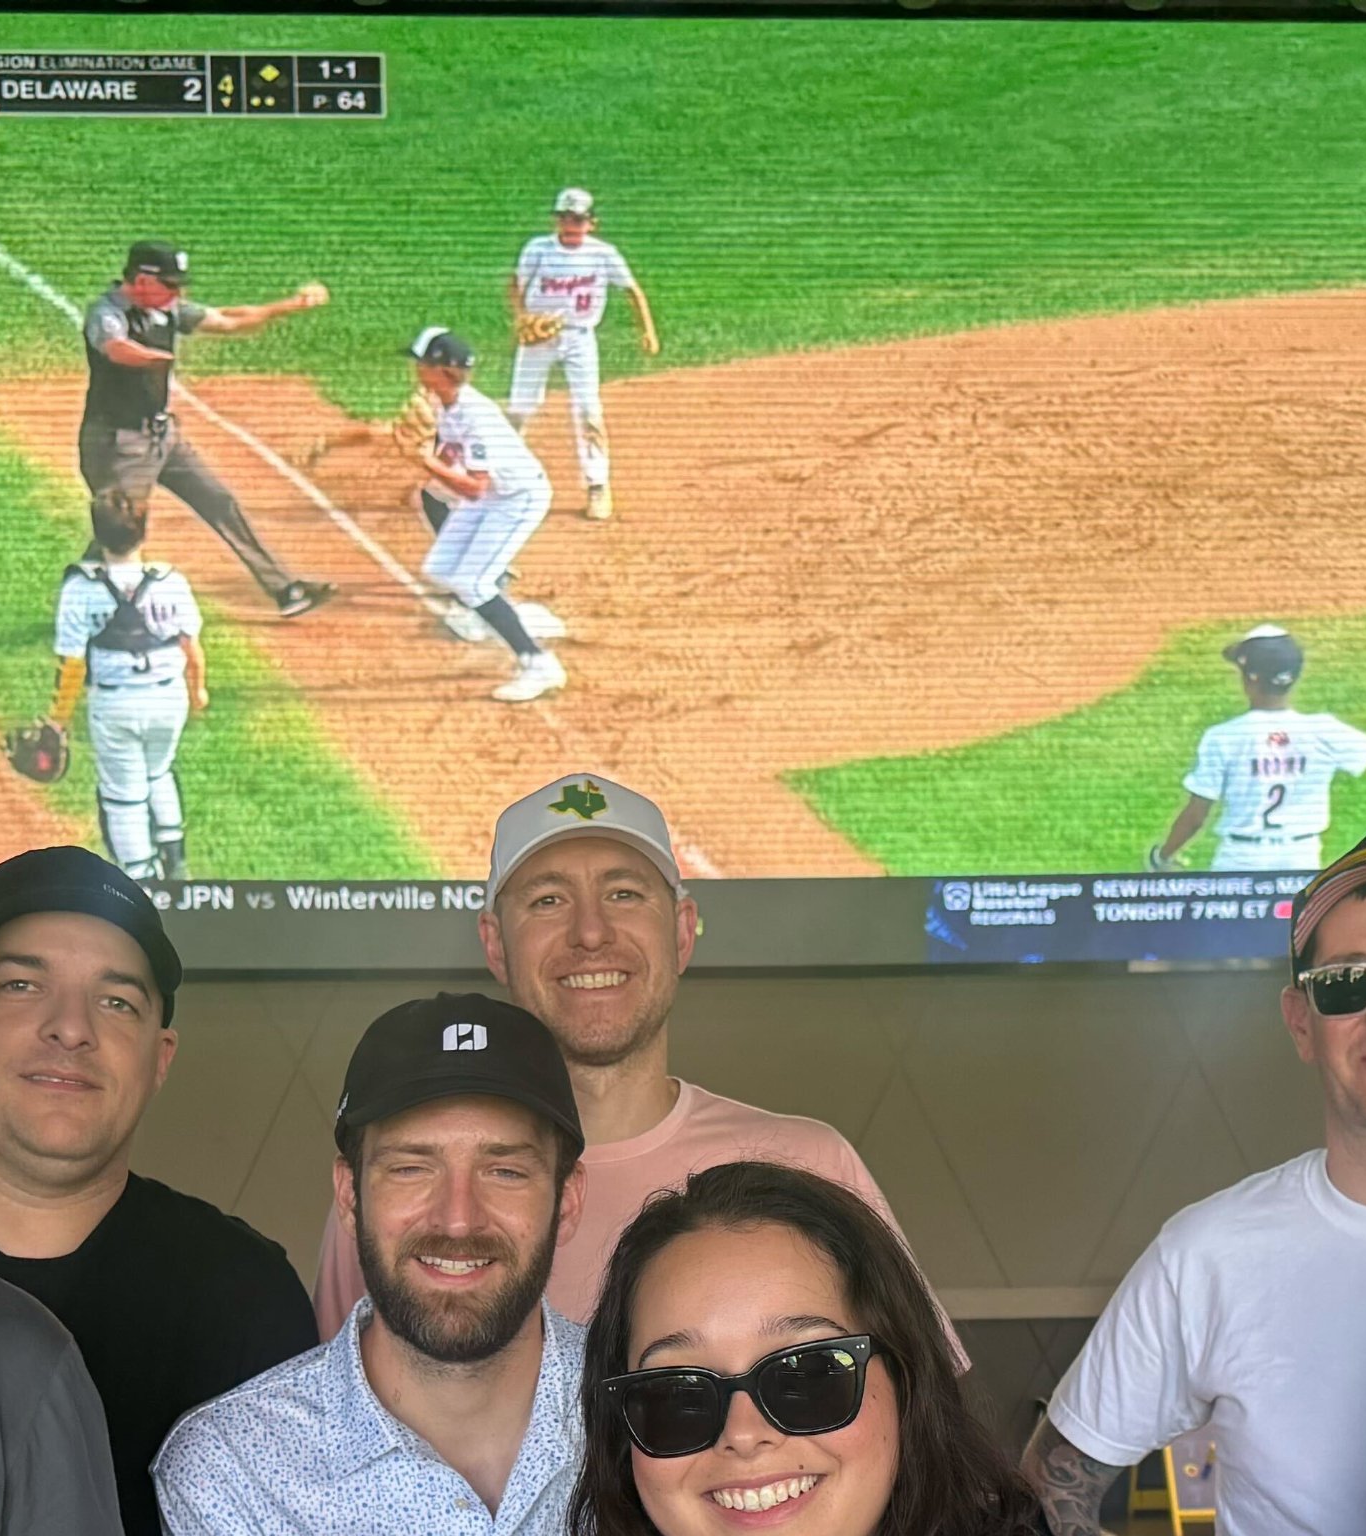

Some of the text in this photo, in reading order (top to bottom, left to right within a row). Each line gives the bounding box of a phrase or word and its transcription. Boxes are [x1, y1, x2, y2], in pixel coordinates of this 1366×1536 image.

[39, 56, 145, 70] ELIMINATION
[148, 56, 197, 71] GAME
[318, 60, 357, 80] 1-1
[1, 77, 203, 102] DELAWARE 2
[217, 74, 235, 96] 4
[337, 91, 366, 110] 64
[1262, 783, 1286, 830] 2
[176, 885, 235, 911] JPN
[246, 891, 276, 910] vs
[286, 885, 436, 911] Winterville
[441, 885, 485, 911] NC
[1093, 879, 1140, 898] NEW
[1140, 877, 1254, 897] HAMPSHIRE
[1093, 901, 1186, 921] TONIGHT
[1242, 900, 1270, 919] ET
